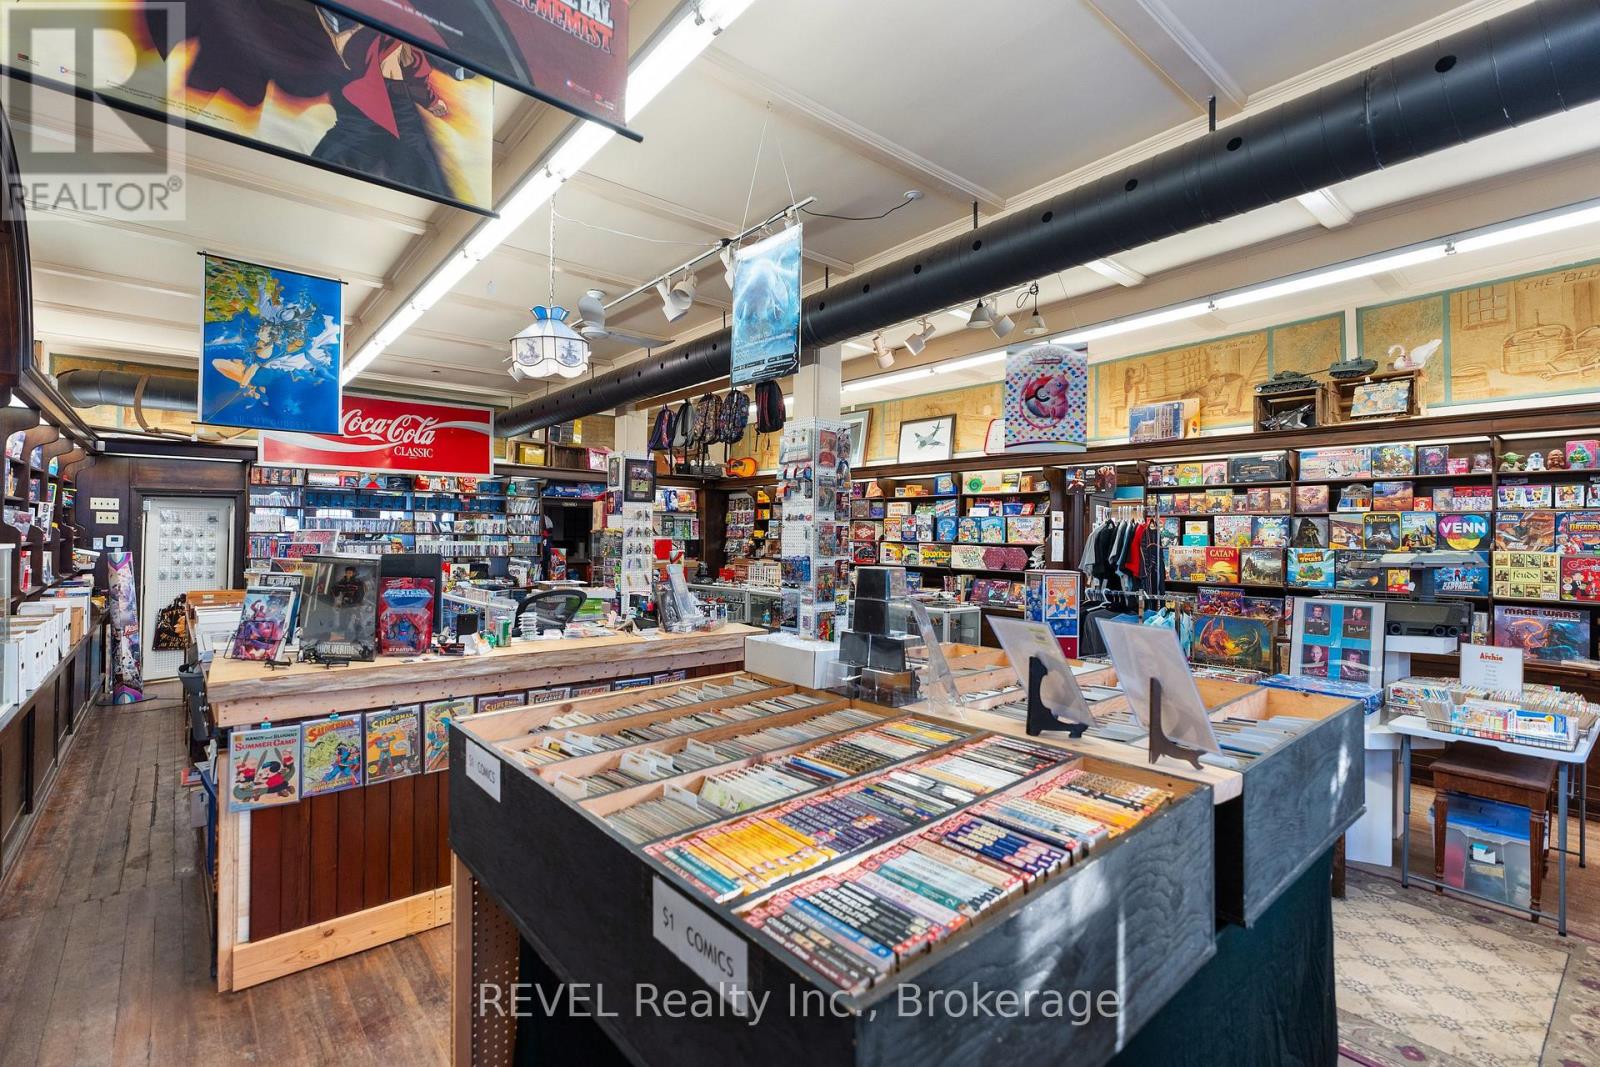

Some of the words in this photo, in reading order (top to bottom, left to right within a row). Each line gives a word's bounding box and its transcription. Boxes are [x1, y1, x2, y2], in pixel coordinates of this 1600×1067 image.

[341, 409, 439, 445] Coca-Cola
[394, 446, 434, 457] CLASSIC
[1441, 522, 1486, 533] VENN
[1210, 549, 1234, 557] CATAN
[1513, 570, 1539, 580] feudo
[1504, 608, 1538, 616] MAGE
[1543, 610, 1580, 618] WARS
[1480, 652, 1503, 661] Archie
[372, 713, 416, 729] SUPERMAN
[235, 742, 272, 752] SUMMER
[273, 739, 297, 747] CAMP
[477, 761, 496, 784] COMICS
[686, 926, 734, 977] COMICS
